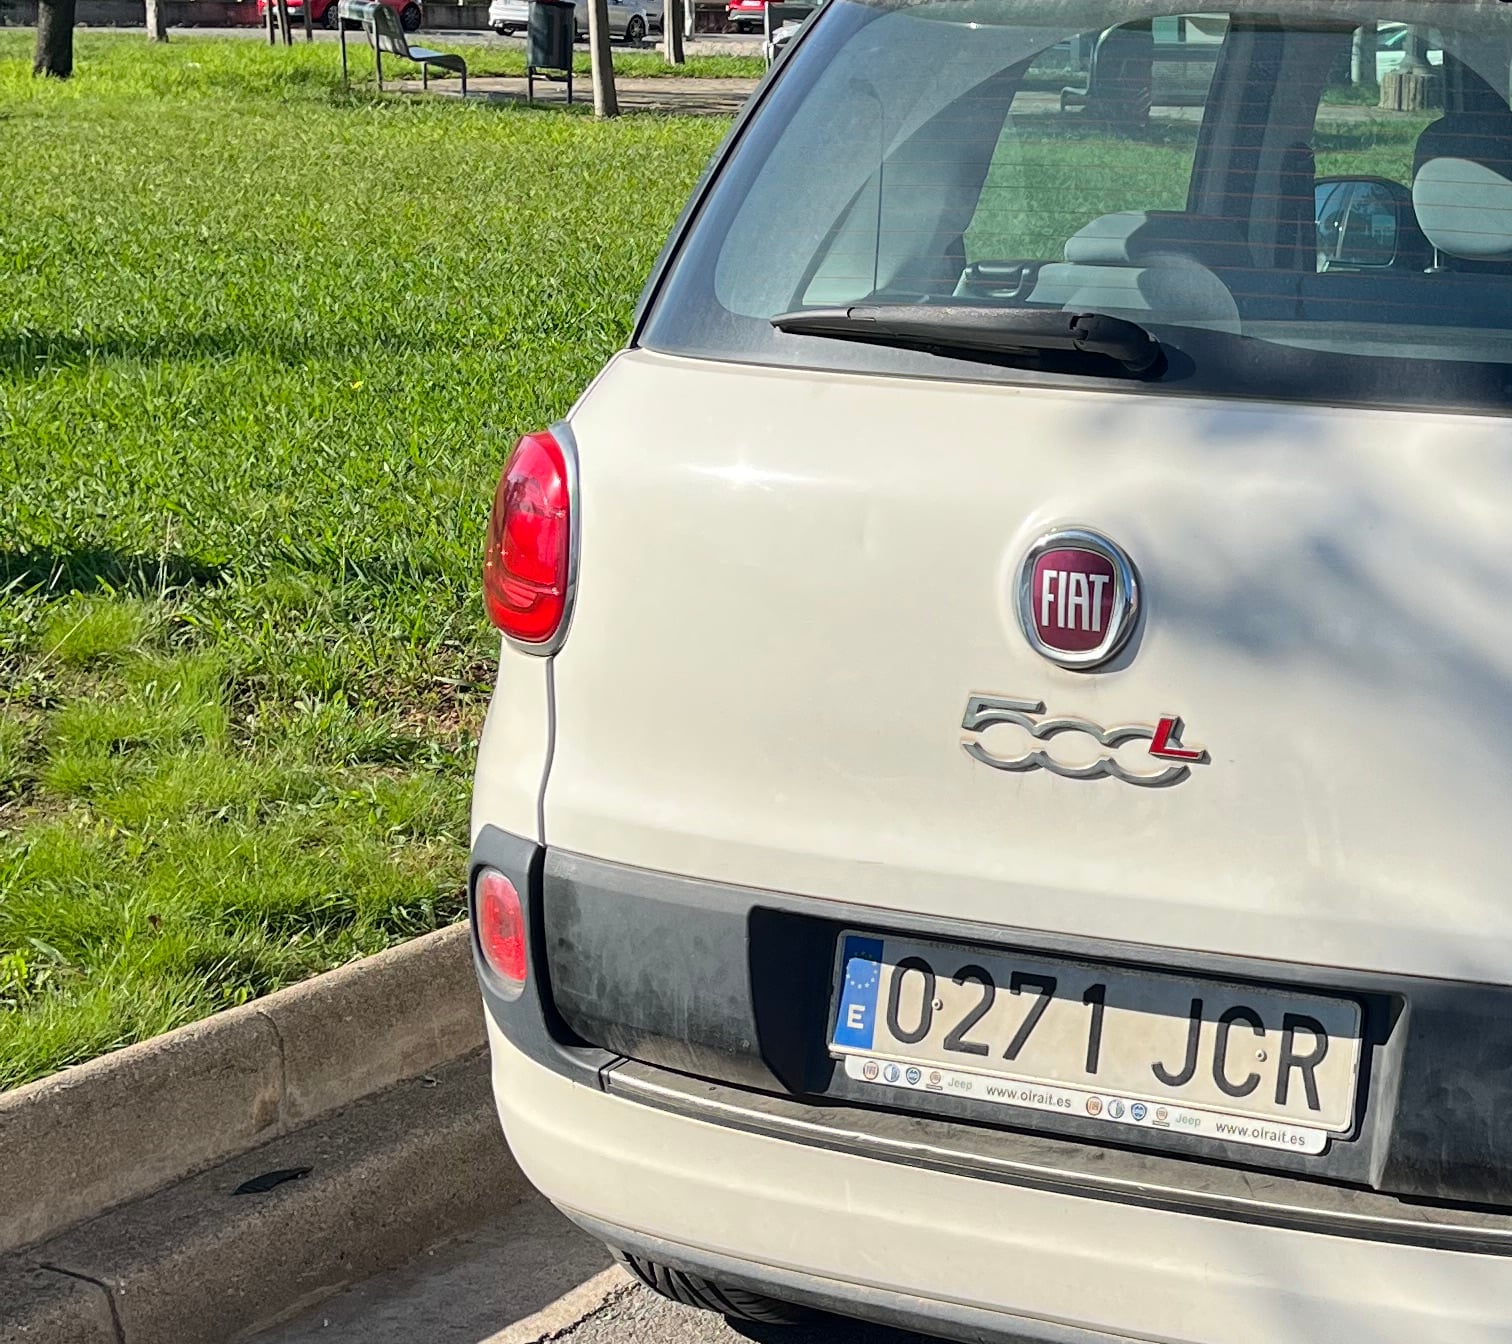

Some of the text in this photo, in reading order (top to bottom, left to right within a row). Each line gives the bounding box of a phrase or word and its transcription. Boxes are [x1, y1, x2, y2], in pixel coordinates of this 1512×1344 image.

[1041, 568, 1110, 632] FIAT
[959, 691, 1212, 788] 500L
[846, 1005, 864, 1030] E
[885, 956, 1330, 1112] 0271 JCR
[947, 1077, 974, 1091] Jeep
[986, 1084, 1073, 1109] www.olrait.es
[1175, 1113, 1201, 1127] Jeep
[1215, 1120, 1306, 1147] www.olrait.es
